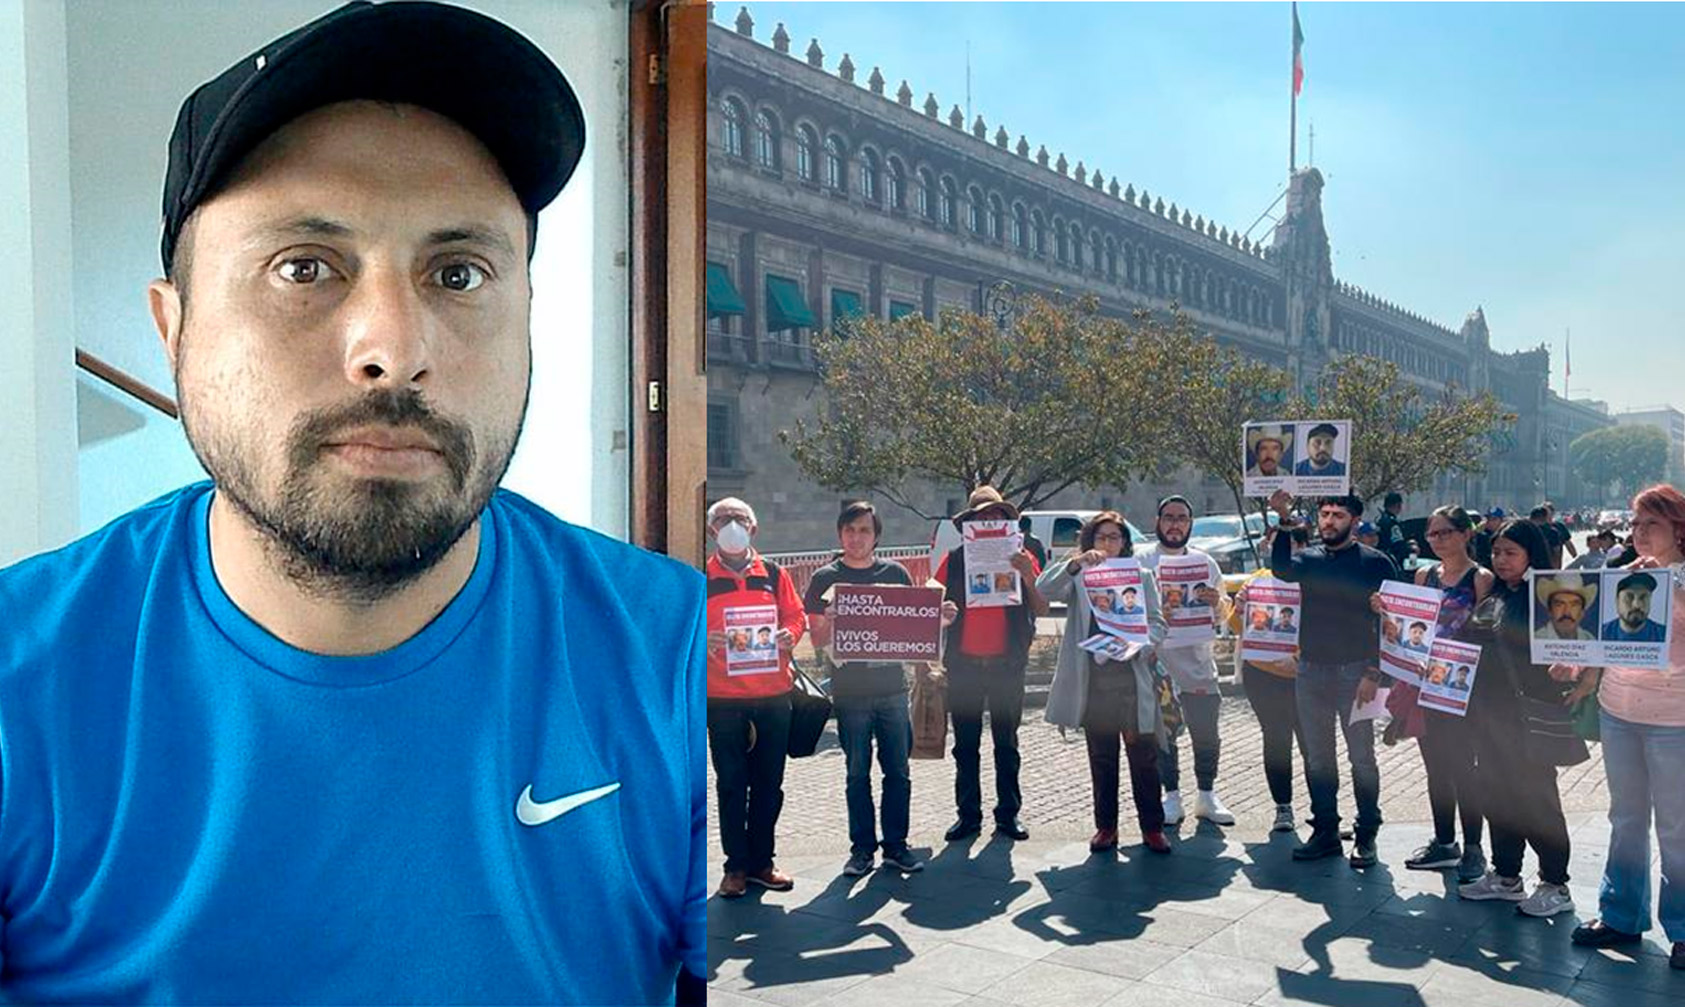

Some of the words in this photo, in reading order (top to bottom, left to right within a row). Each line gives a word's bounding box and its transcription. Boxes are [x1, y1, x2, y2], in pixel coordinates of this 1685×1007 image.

[837, 594, 884, 606] ¡HASTA
[837, 605, 940, 618] ENCONTRARLOS!
[836, 630, 879, 641] ¡VIVOS
[836, 641, 861, 652] LOS
[863, 642, 937, 654] QUEREMOS!
